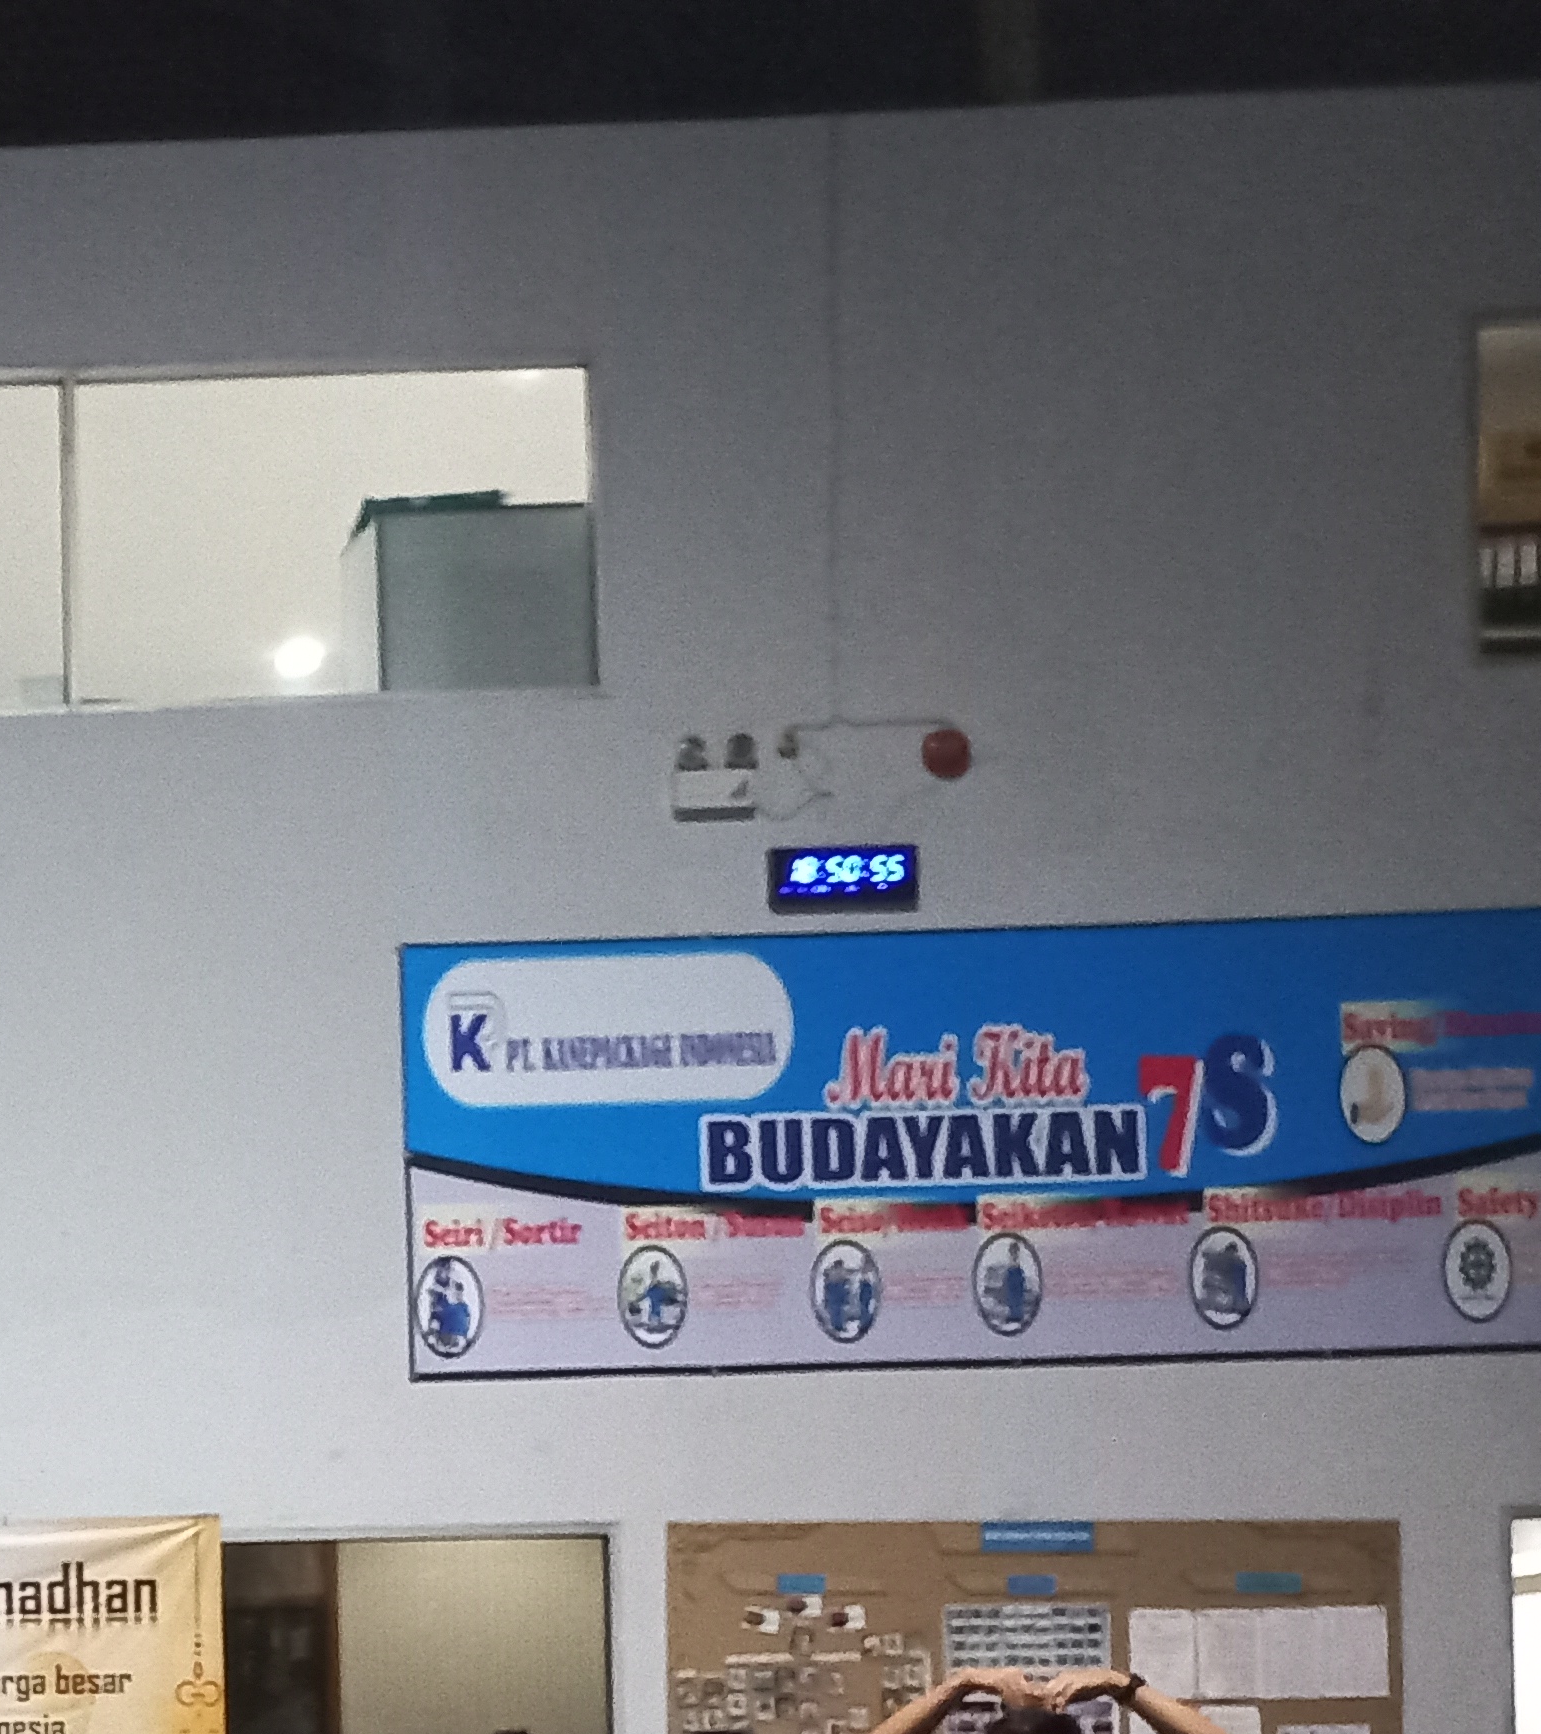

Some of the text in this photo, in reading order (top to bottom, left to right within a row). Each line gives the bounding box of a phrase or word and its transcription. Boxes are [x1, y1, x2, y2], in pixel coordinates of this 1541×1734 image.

[449, 1013, 492, 1073] K
[826, 1024, 1086, 1104] Mari Kita
[707, 1110, 1140, 1184] BUDAYAKAN
[54, 1663, 133, 1696] besar
